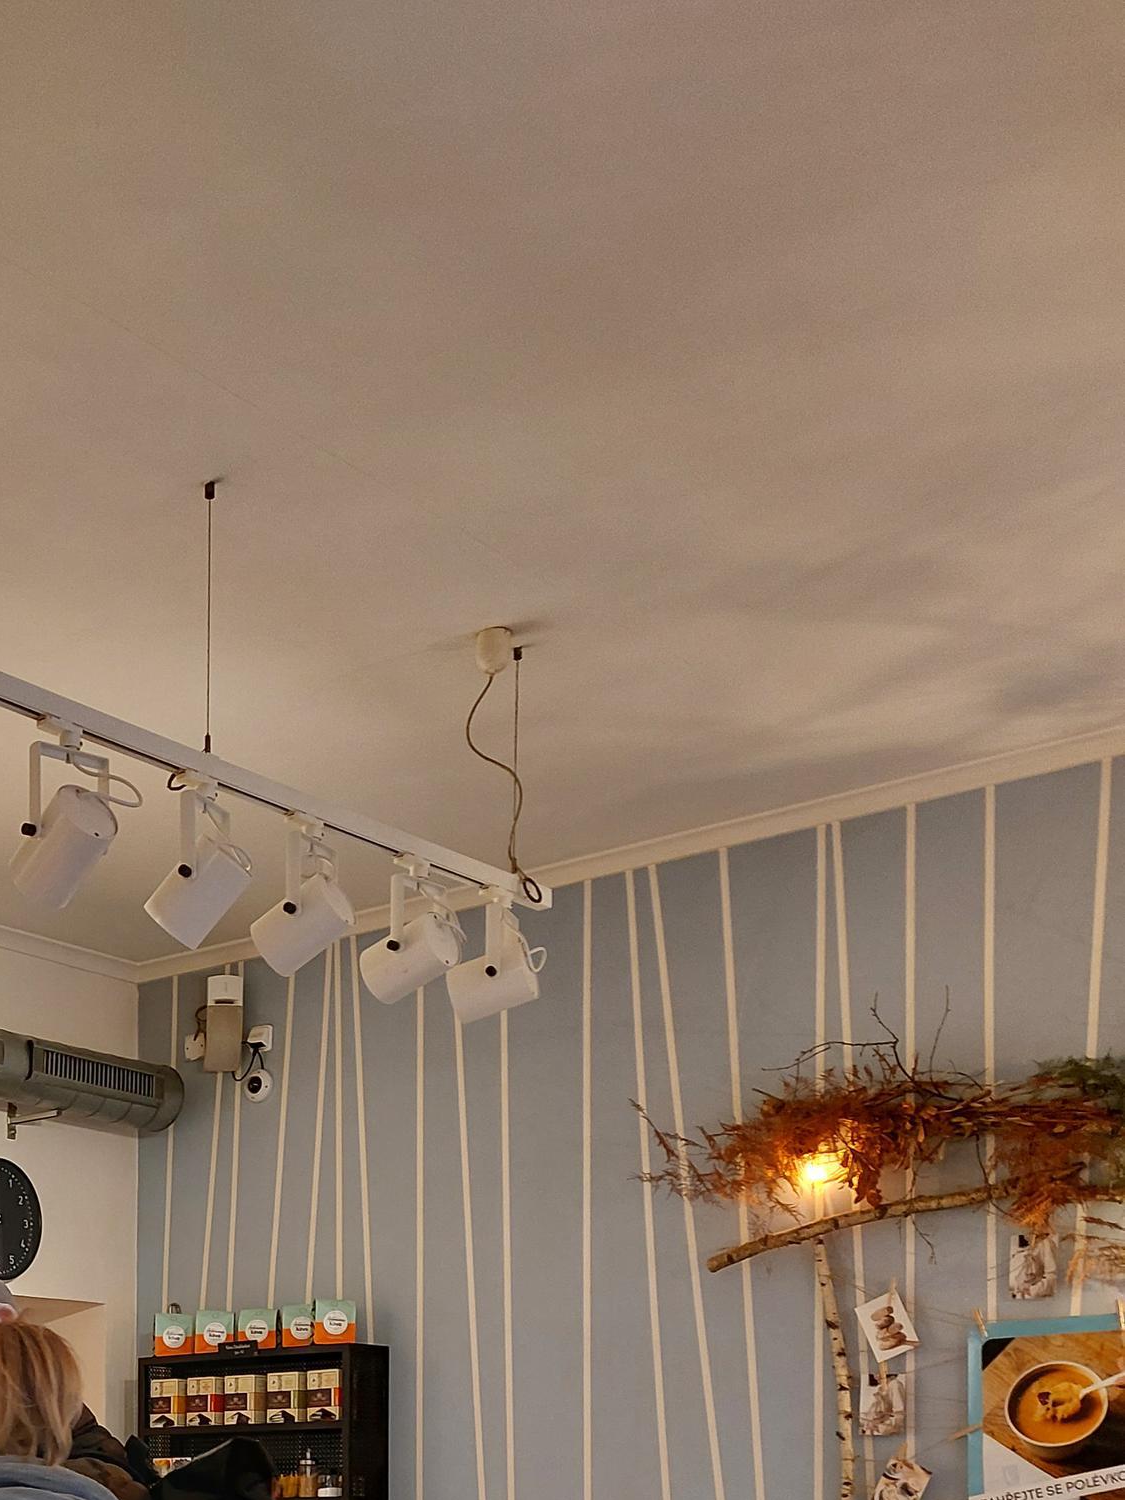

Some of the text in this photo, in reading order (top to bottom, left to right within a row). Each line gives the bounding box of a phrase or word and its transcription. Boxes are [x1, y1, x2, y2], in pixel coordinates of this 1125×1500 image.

[9, 1179, 13, 1188] 1
[18, 1196, 23, 1205] 2
[23, 1220, 29, 1228] 3
[9, 1255, 14, 1264] 5
[1046, 1483, 1063, 1496] SE
